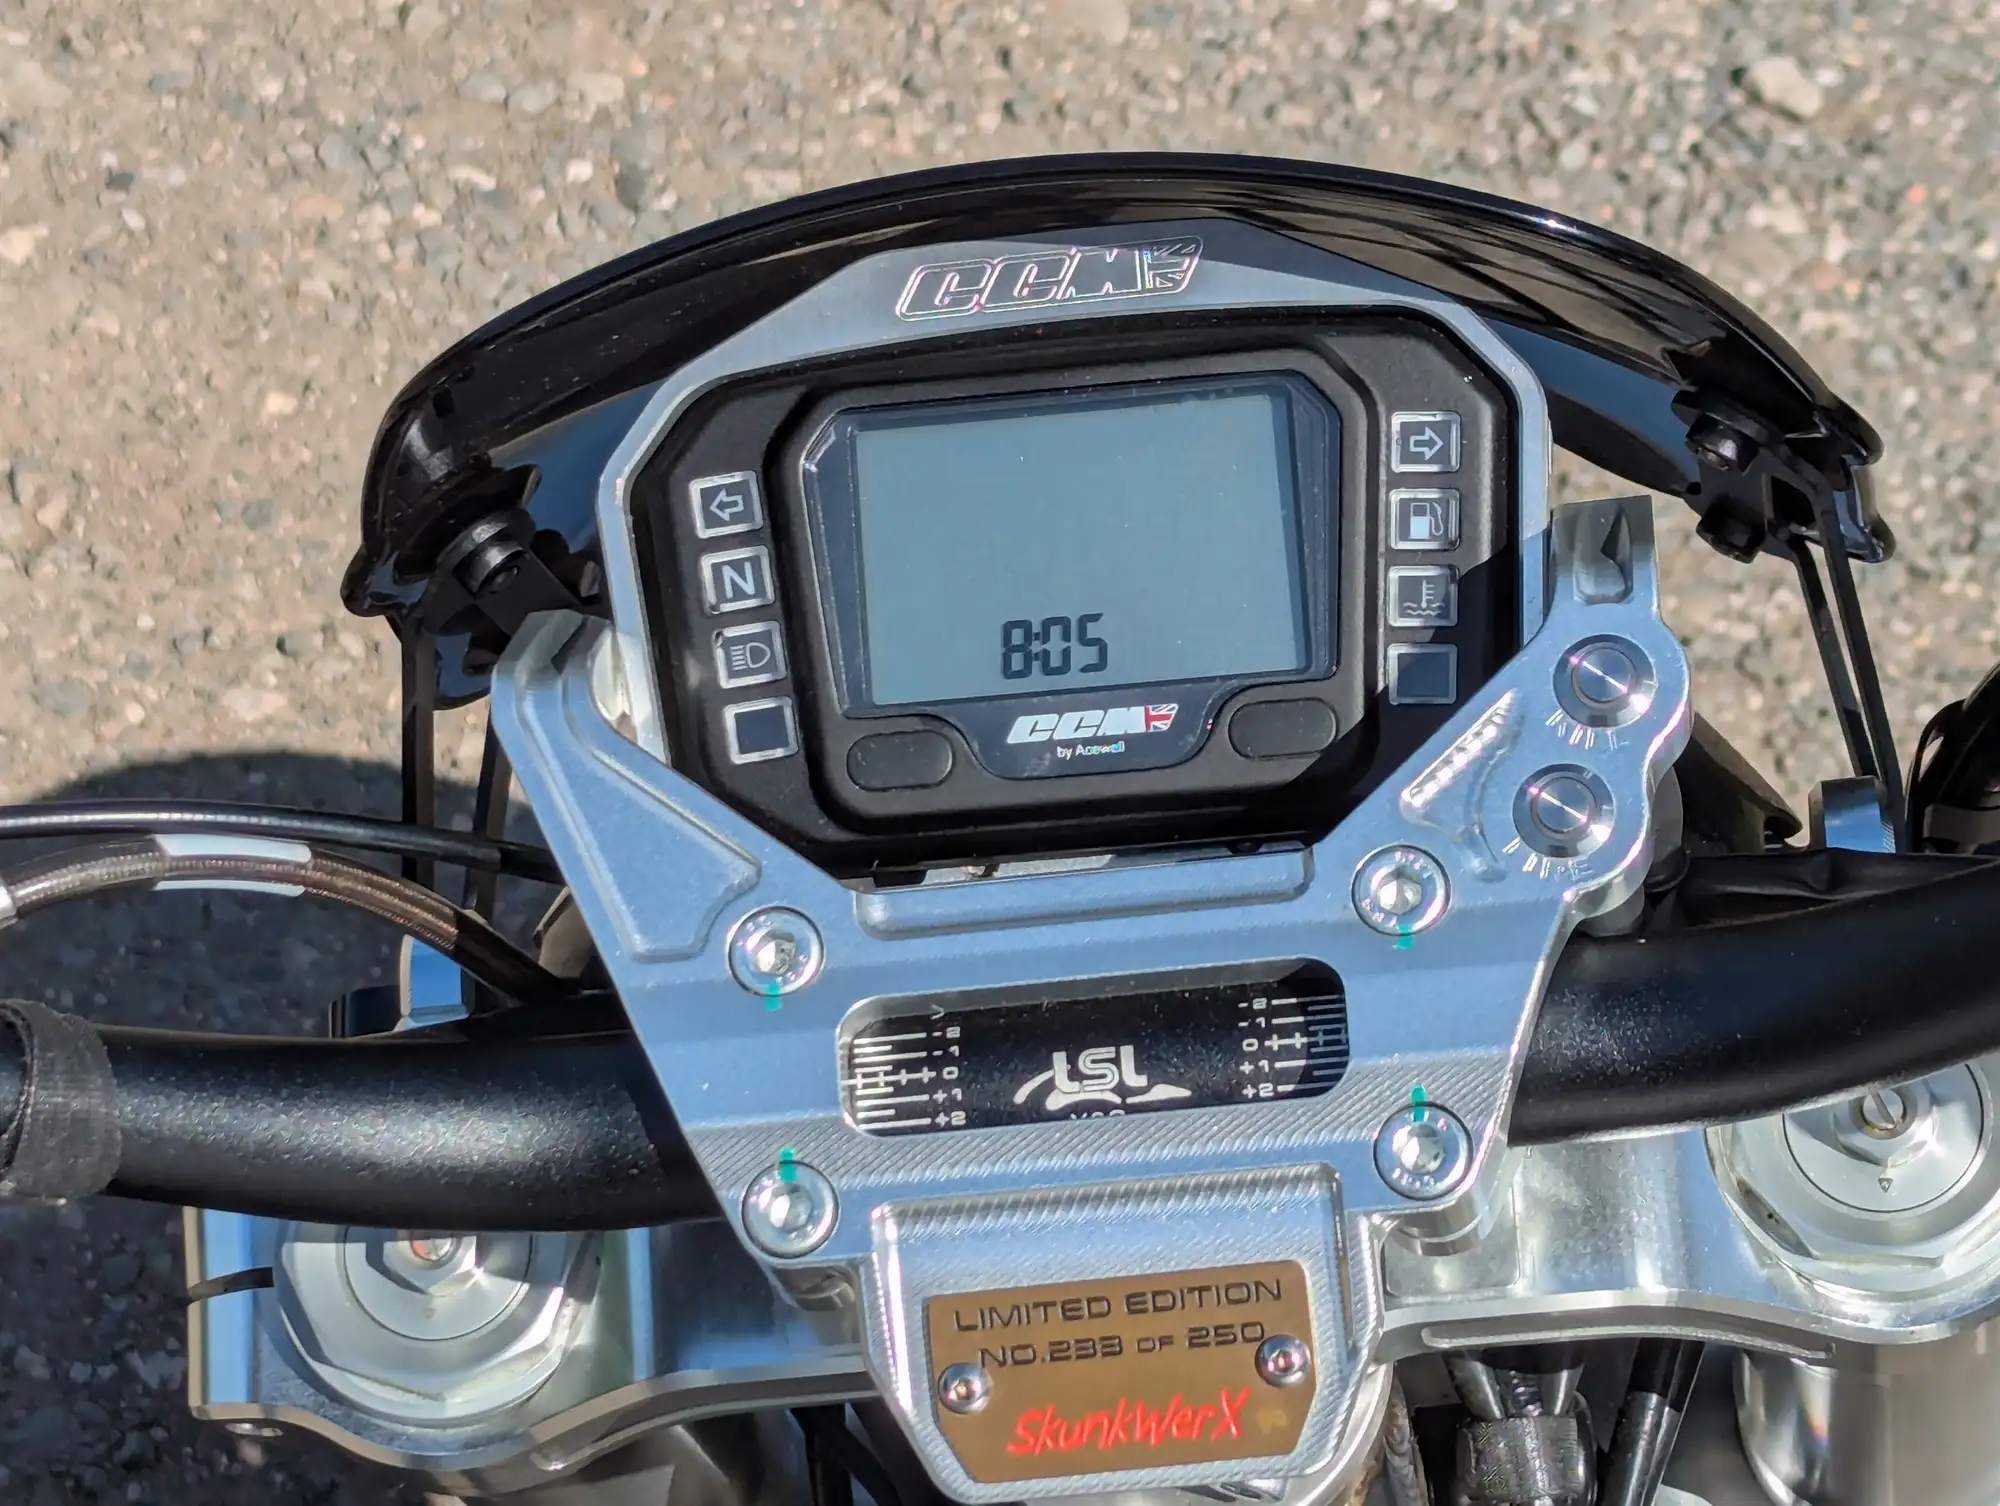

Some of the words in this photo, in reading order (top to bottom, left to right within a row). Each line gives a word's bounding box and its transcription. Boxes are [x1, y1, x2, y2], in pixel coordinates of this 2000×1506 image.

[896, 247, 1148, 321] CCM
[721, 560, 756, 600] N
[1002, 612, 1108, 680] 8:05
[1006, 704, 1148, 744] CCM
[1056, 745, 1073, 760] by
[1052, 1044, 1149, 1094] LSL
[1239, 1059, 1270, 1076] +1
[932, 1088, 963, 1104] +1
[1242, 1082, 1275, 1099] +2
[934, 1110, 967, 1127] +2
[954, 1296, 1112, 1333] LIMITED
[1123, 1278, 1283, 1315] EDITION
[978, 1335, 1124, 1368] NO.233
[1136, 1334, 1175, 1355] OF
[1185, 1321, 1266, 1351] 250
